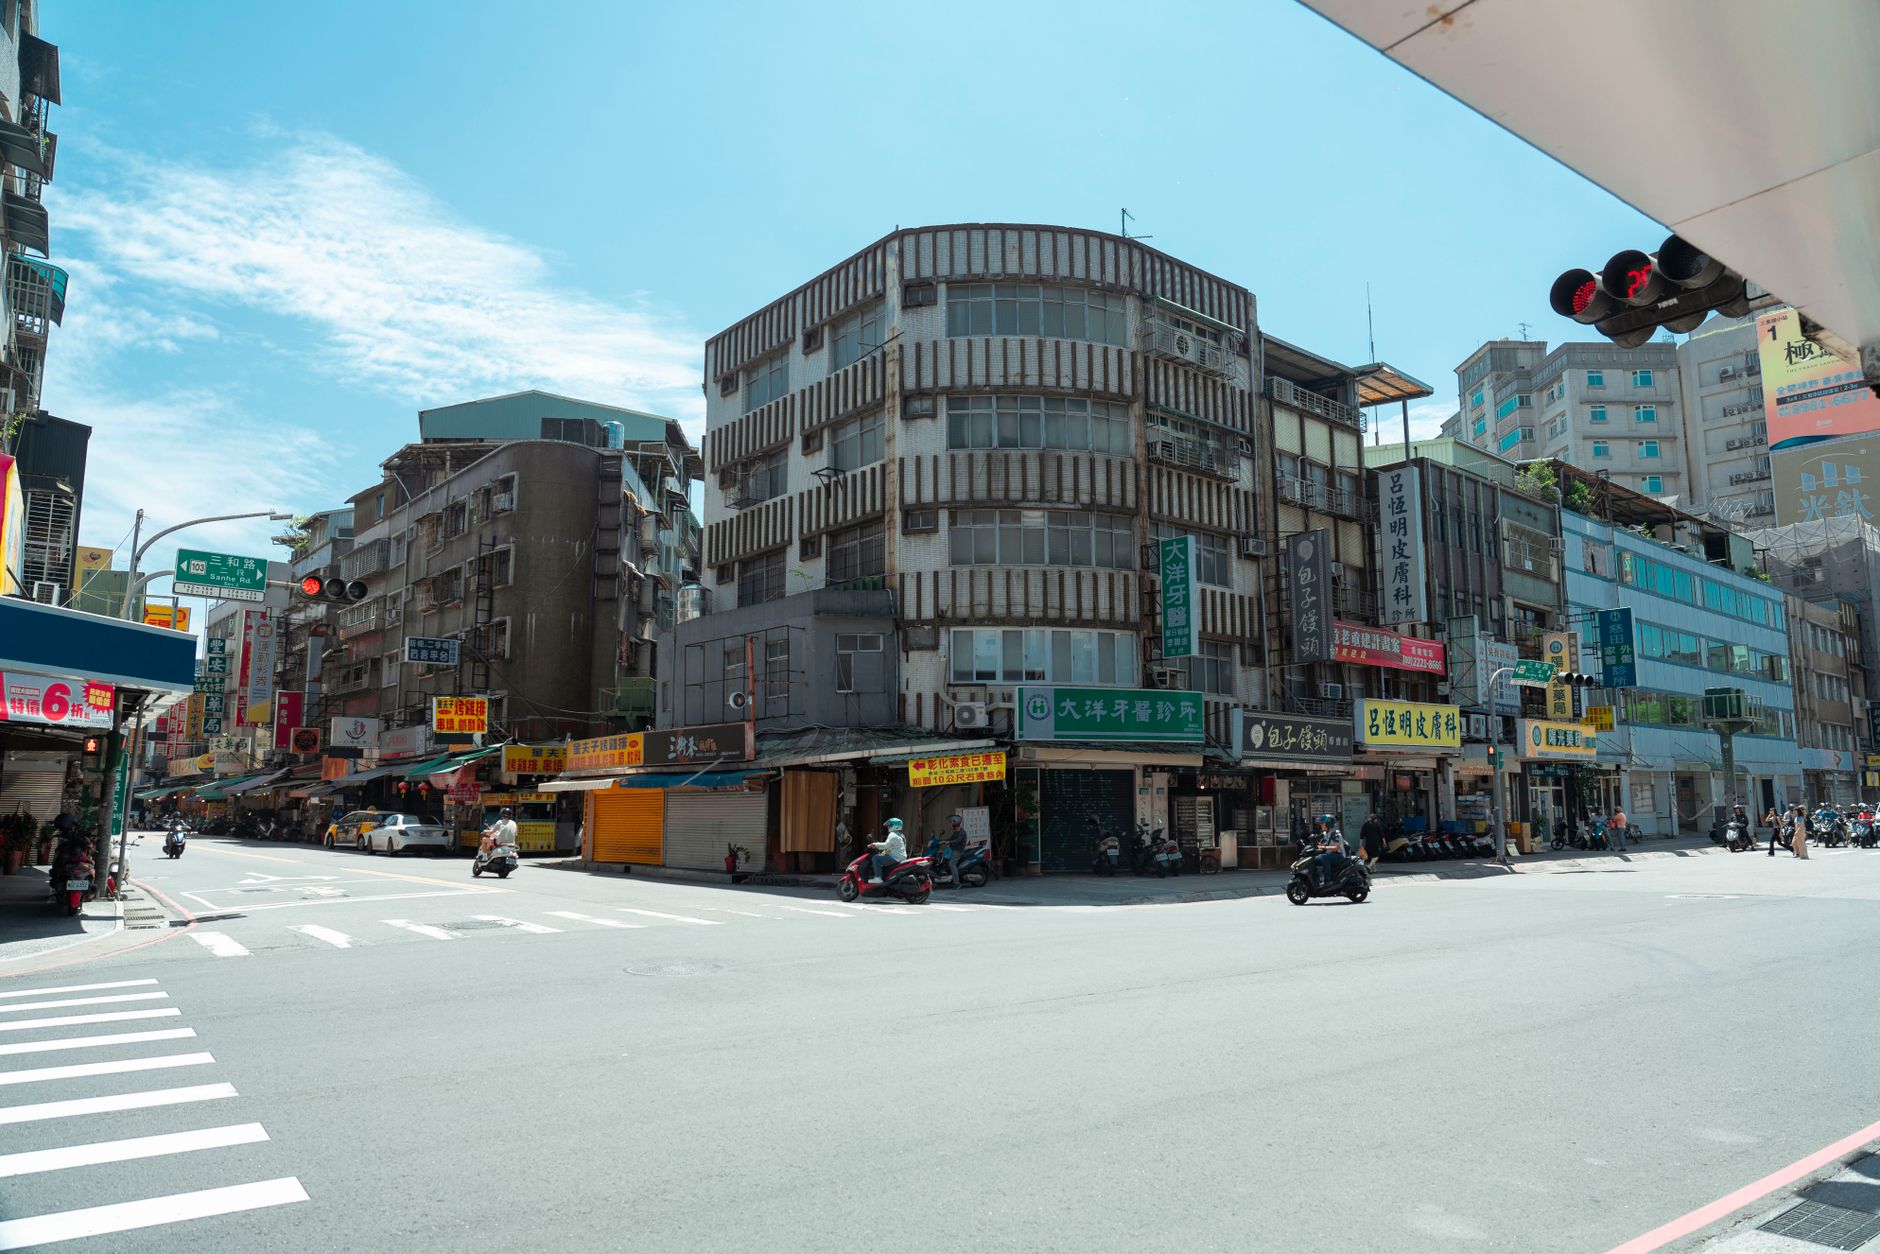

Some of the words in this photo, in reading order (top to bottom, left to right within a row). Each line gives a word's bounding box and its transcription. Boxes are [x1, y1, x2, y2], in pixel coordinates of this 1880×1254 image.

[1768, 325, 1777, 341] 1
[191, 563, 205, 572] 103
[209, 555, 256, 570] 三和路
[210, 573, 236, 582] Sanhe
[220, 567, 245, 576] 二段
[1165, 541, 1187, 627] 大洋牙醫
[1612, 665, 1627, 687] 診所
[1057, 698, 1198, 723] 大洋牙醫診所
[927, 753, 1004, 770] 彰化素食已遷至
